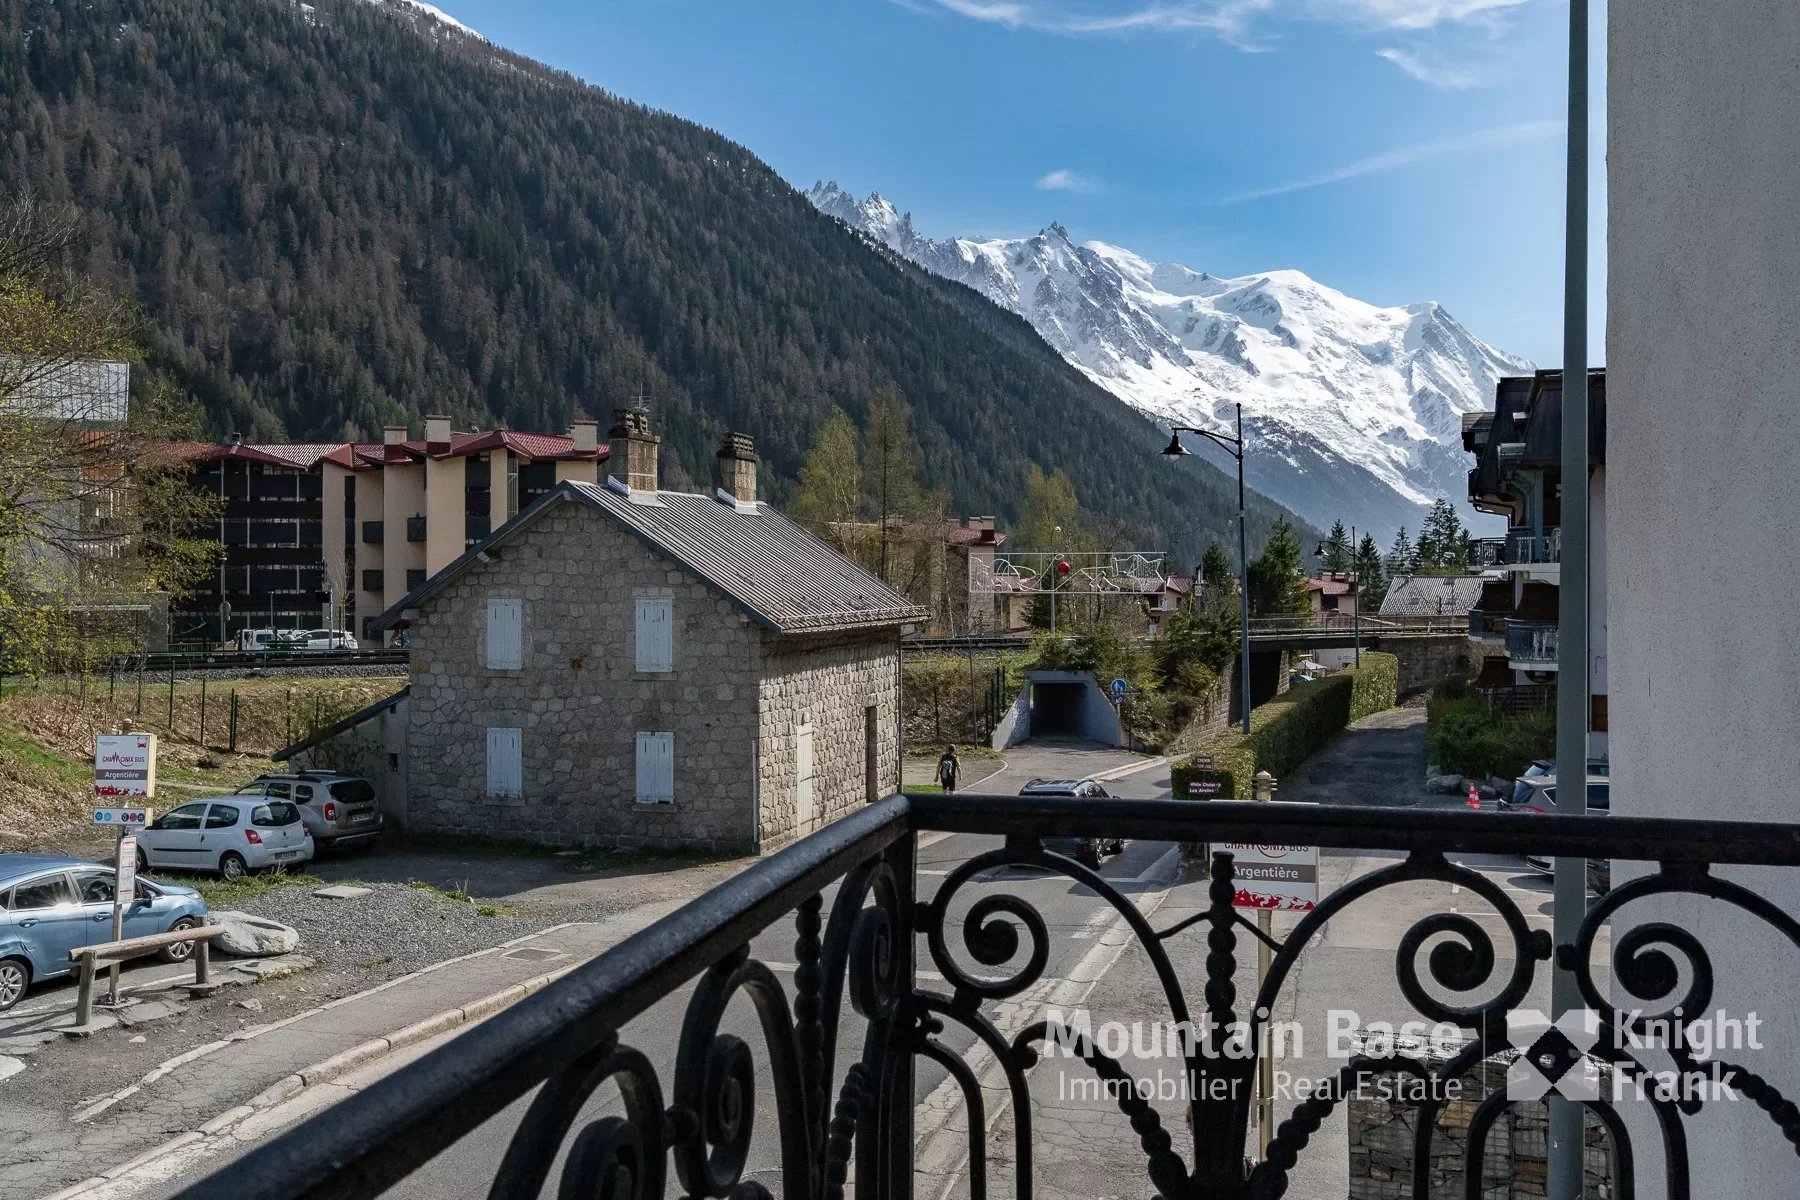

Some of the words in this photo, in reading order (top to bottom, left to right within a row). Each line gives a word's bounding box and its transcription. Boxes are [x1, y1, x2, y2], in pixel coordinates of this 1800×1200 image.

[102, 752, 134, 764] CHAMONIX
[104, 771, 139, 779] Argentière
[1233, 865, 1299, 879] Argentière
